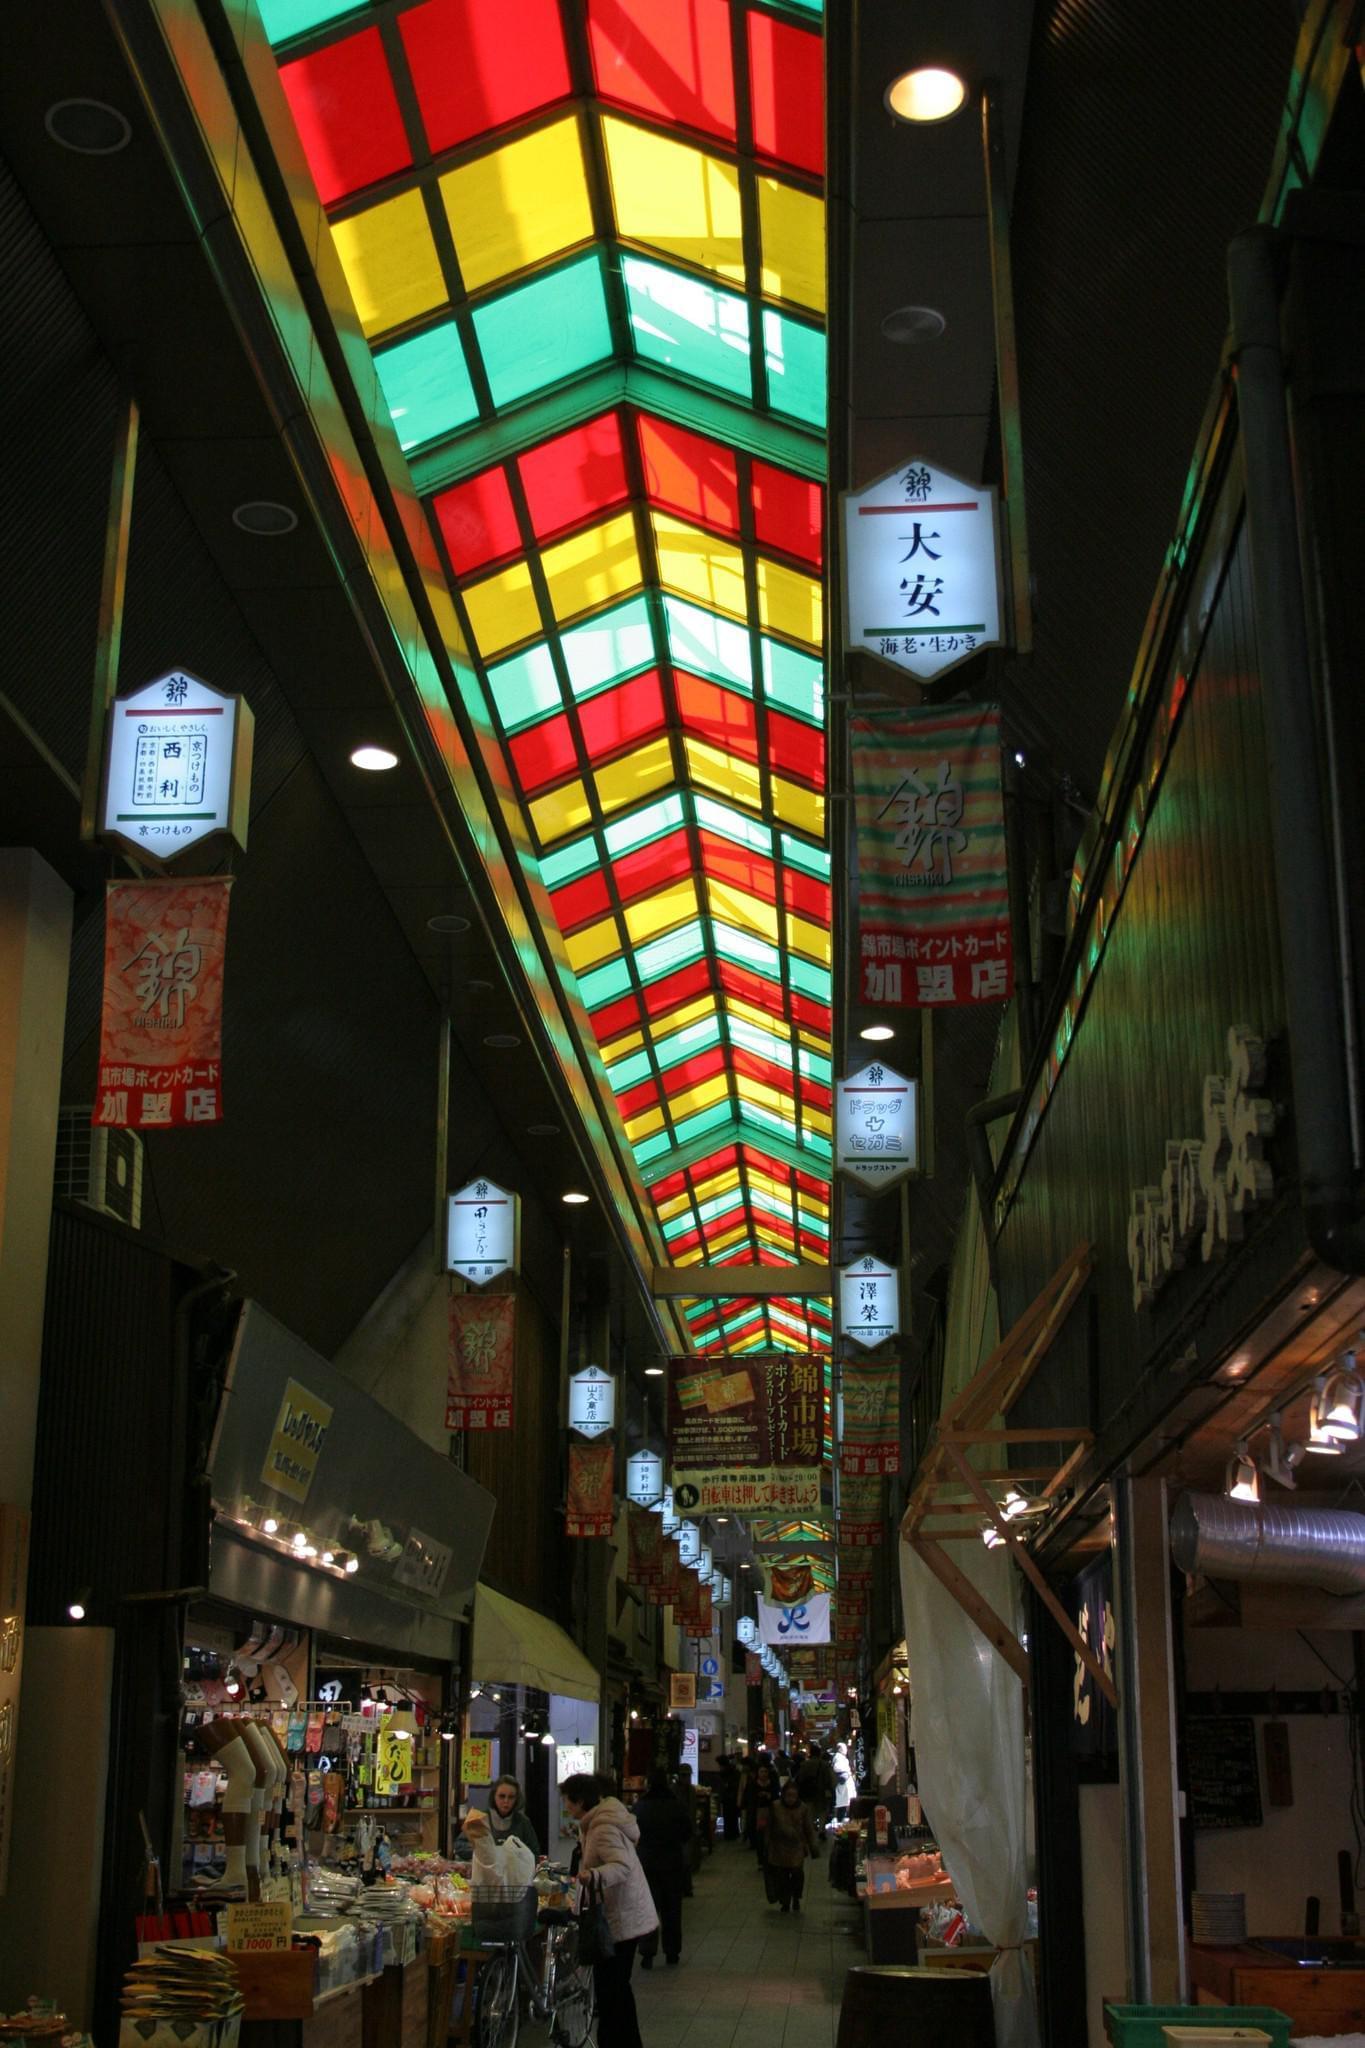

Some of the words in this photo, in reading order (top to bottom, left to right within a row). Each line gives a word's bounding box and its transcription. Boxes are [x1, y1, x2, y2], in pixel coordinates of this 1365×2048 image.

[898, 522, 944, 618] 大安
[879, 634, 977, 656] 海老・生かき
[160, 741, 182, 798] 西利
[189, 741, 203, 793] 京つけもの
[139, 825, 192, 836] 京つけもの
[876, 760, 968, 886] 錦
[861, 931, 1008, 960] 錦市場ポイントカード
[122, 928, 202, 1029] 錦
[864, 959, 1007, 1002] 加盟店
[99, 1088, 217, 1124] 加盟店
[849, 1099, 902, 1115] ドラッグ
[849, 1134, 902, 1151] セガミ
[775, 1363, 789, 1461] ポイントカード
[790, 1363, 819, 1457] 錦市場
[701, 1484, 819, 1506] 自転車は押して歩きましょう
